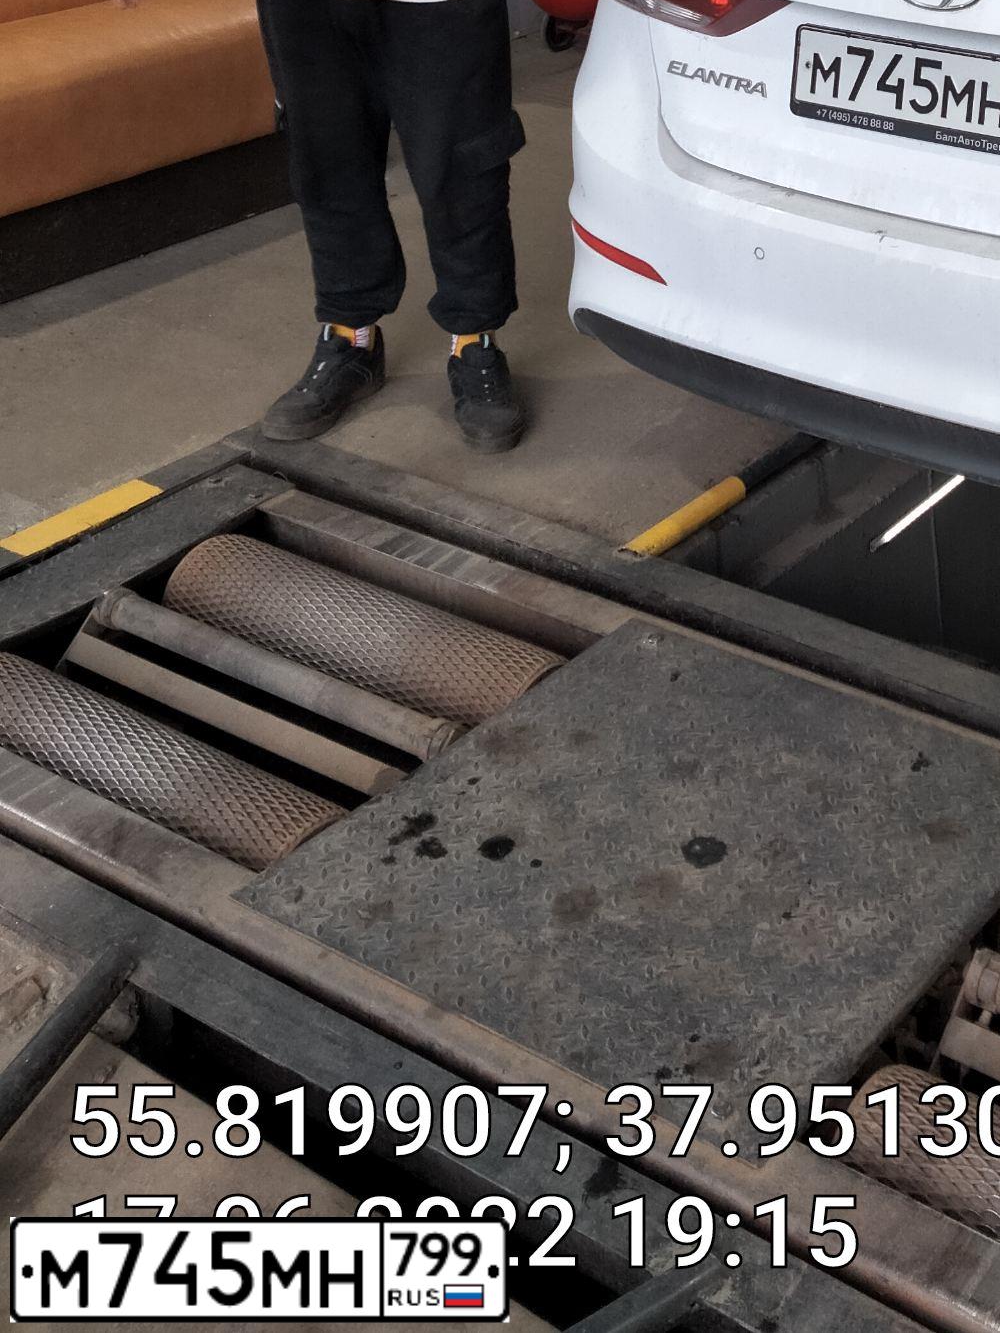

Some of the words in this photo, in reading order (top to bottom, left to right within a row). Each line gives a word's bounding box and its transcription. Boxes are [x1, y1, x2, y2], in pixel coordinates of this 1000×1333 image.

[666, 59, 768, 98] ELANTRA
[816, 109, 827, 118] +7
[828, 109, 851, 124] (495)
[852, 113, 869, 127] 478
[870, 117, 882, 129] 88
[883, 120, 895, 131] 88
